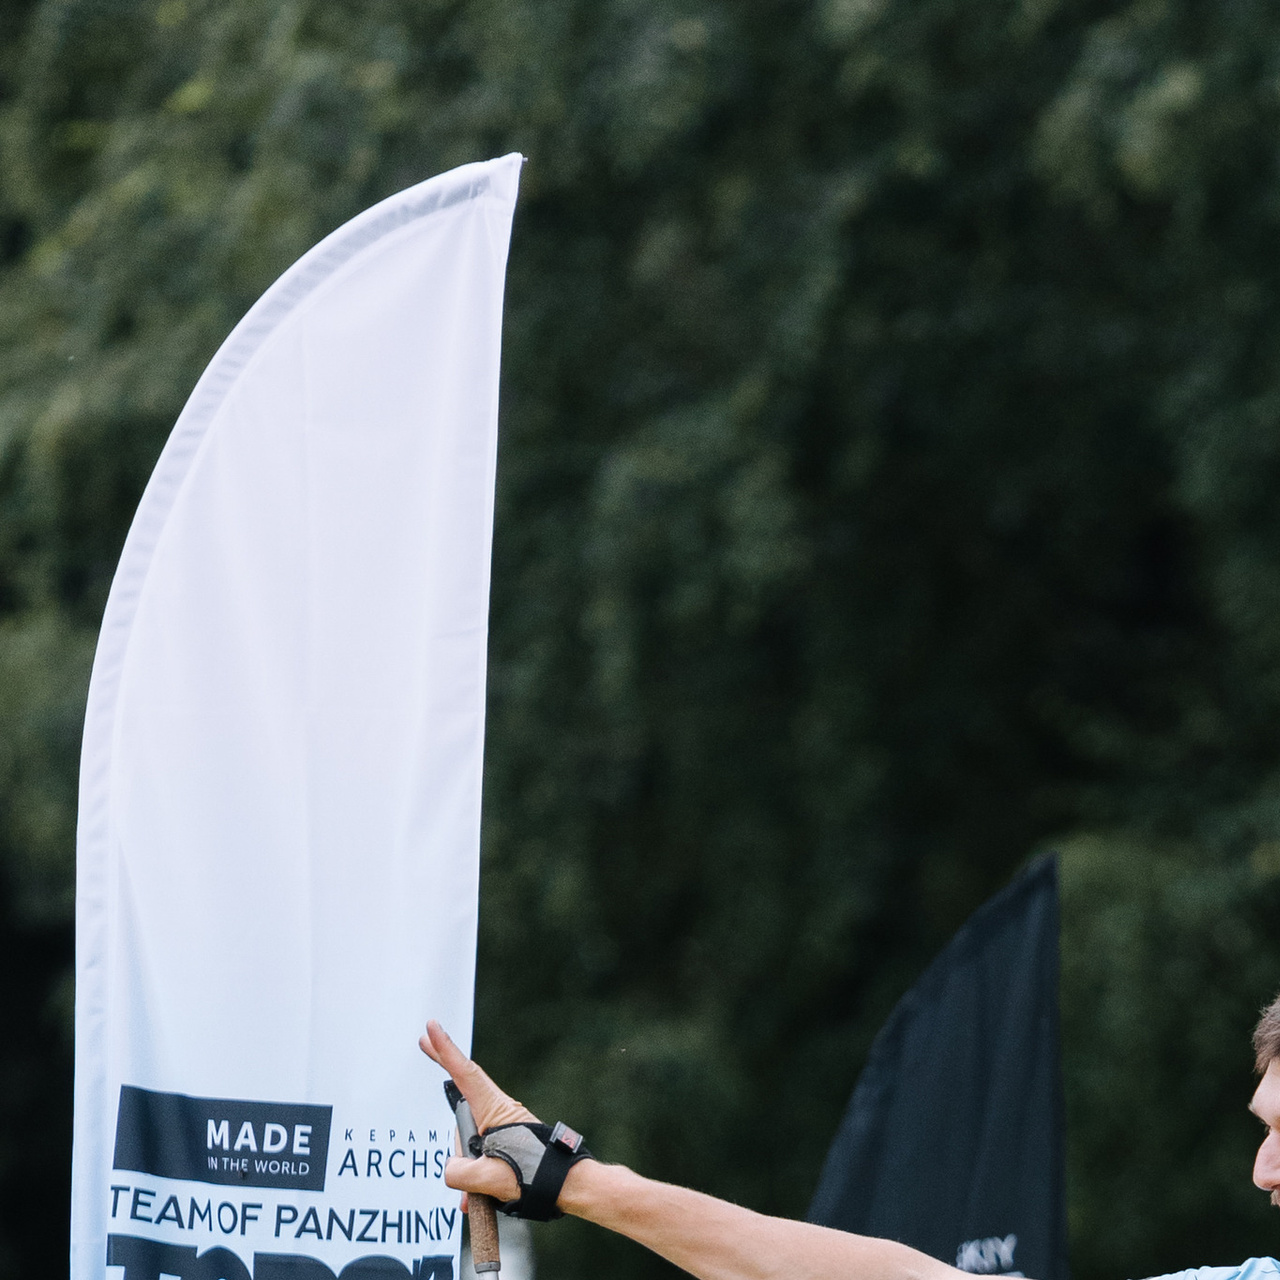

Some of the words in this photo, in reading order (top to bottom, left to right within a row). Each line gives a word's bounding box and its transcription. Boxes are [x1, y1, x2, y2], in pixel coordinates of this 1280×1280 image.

[206, 1119, 312, 1155] MADE
[207, 1156, 218, 1171] IN
[222, 1157, 248, 1173] THE
[254, 1160, 310, 1175] WORLD
[338, 1148, 451, 1178] ARCHS
[110, 1185, 213, 1232] TEAM
[217, 1201, 262, 1236] OF
